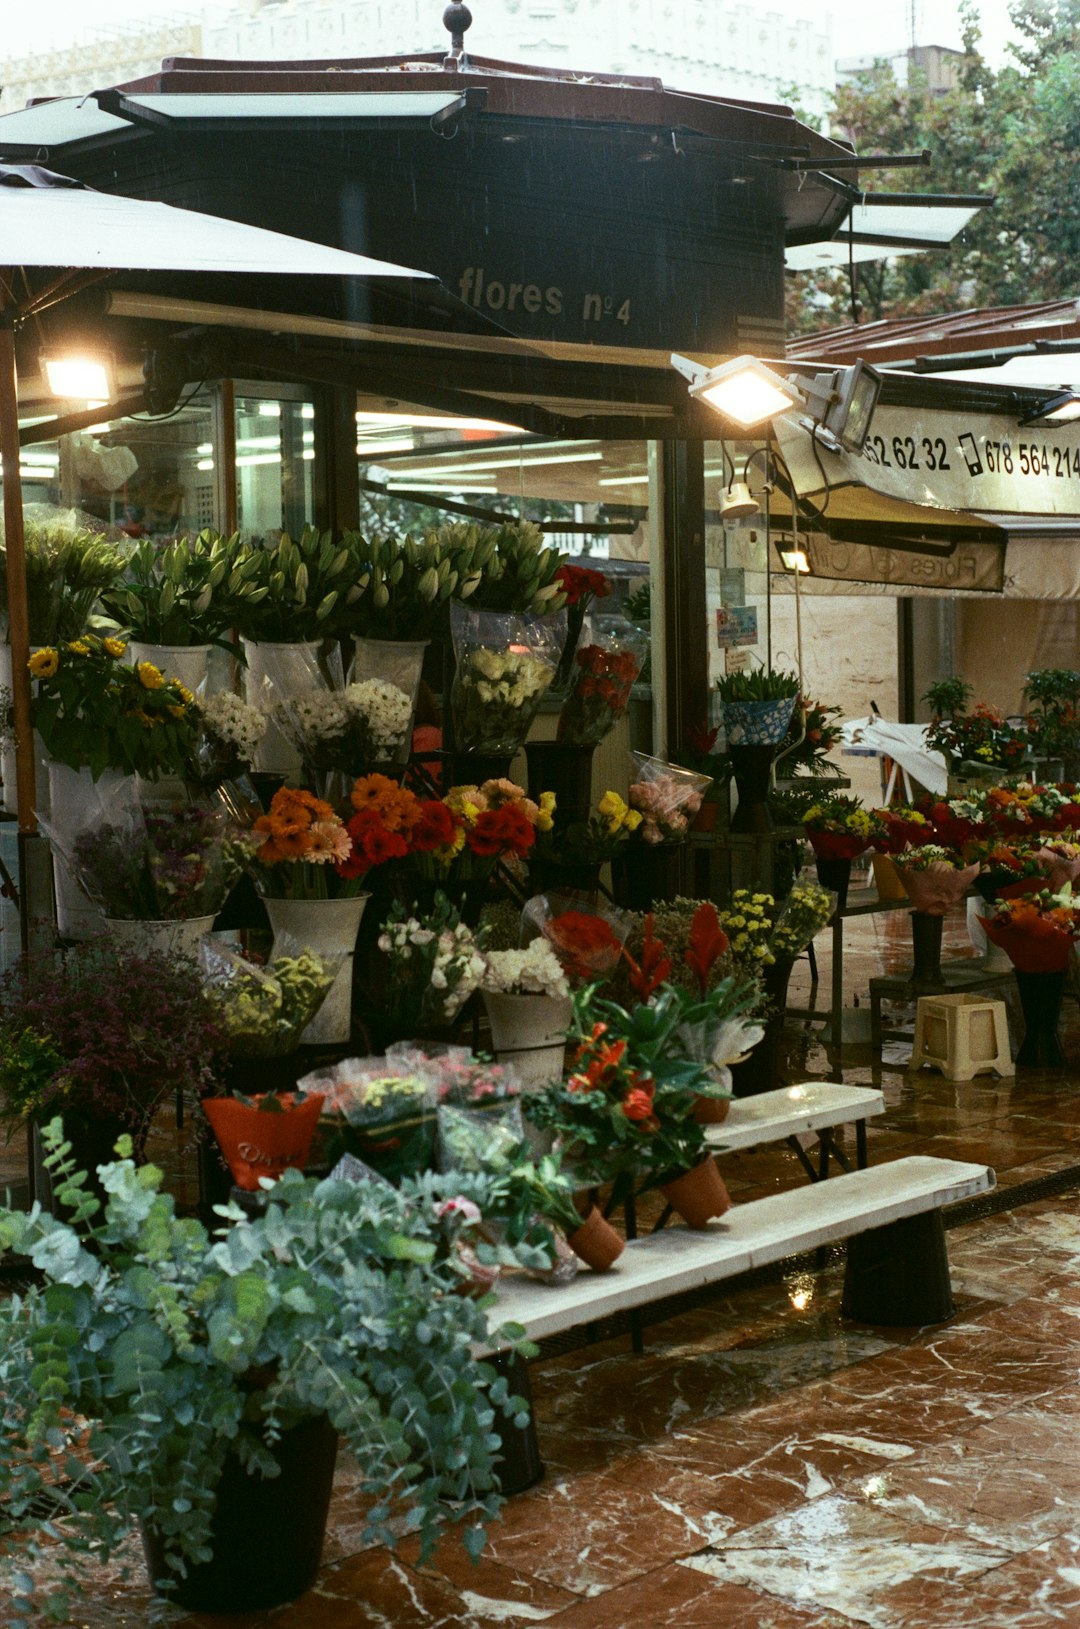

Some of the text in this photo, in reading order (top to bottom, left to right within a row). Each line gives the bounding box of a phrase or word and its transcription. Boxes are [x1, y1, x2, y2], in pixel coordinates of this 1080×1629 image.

[458, 267, 562, 315] flores
[616, 299, 630, 325] 4
[893, 436, 920, 470] 62
[922, 437, 951, 471] 32
[985, 440, 1080, 478] 678 564 214
